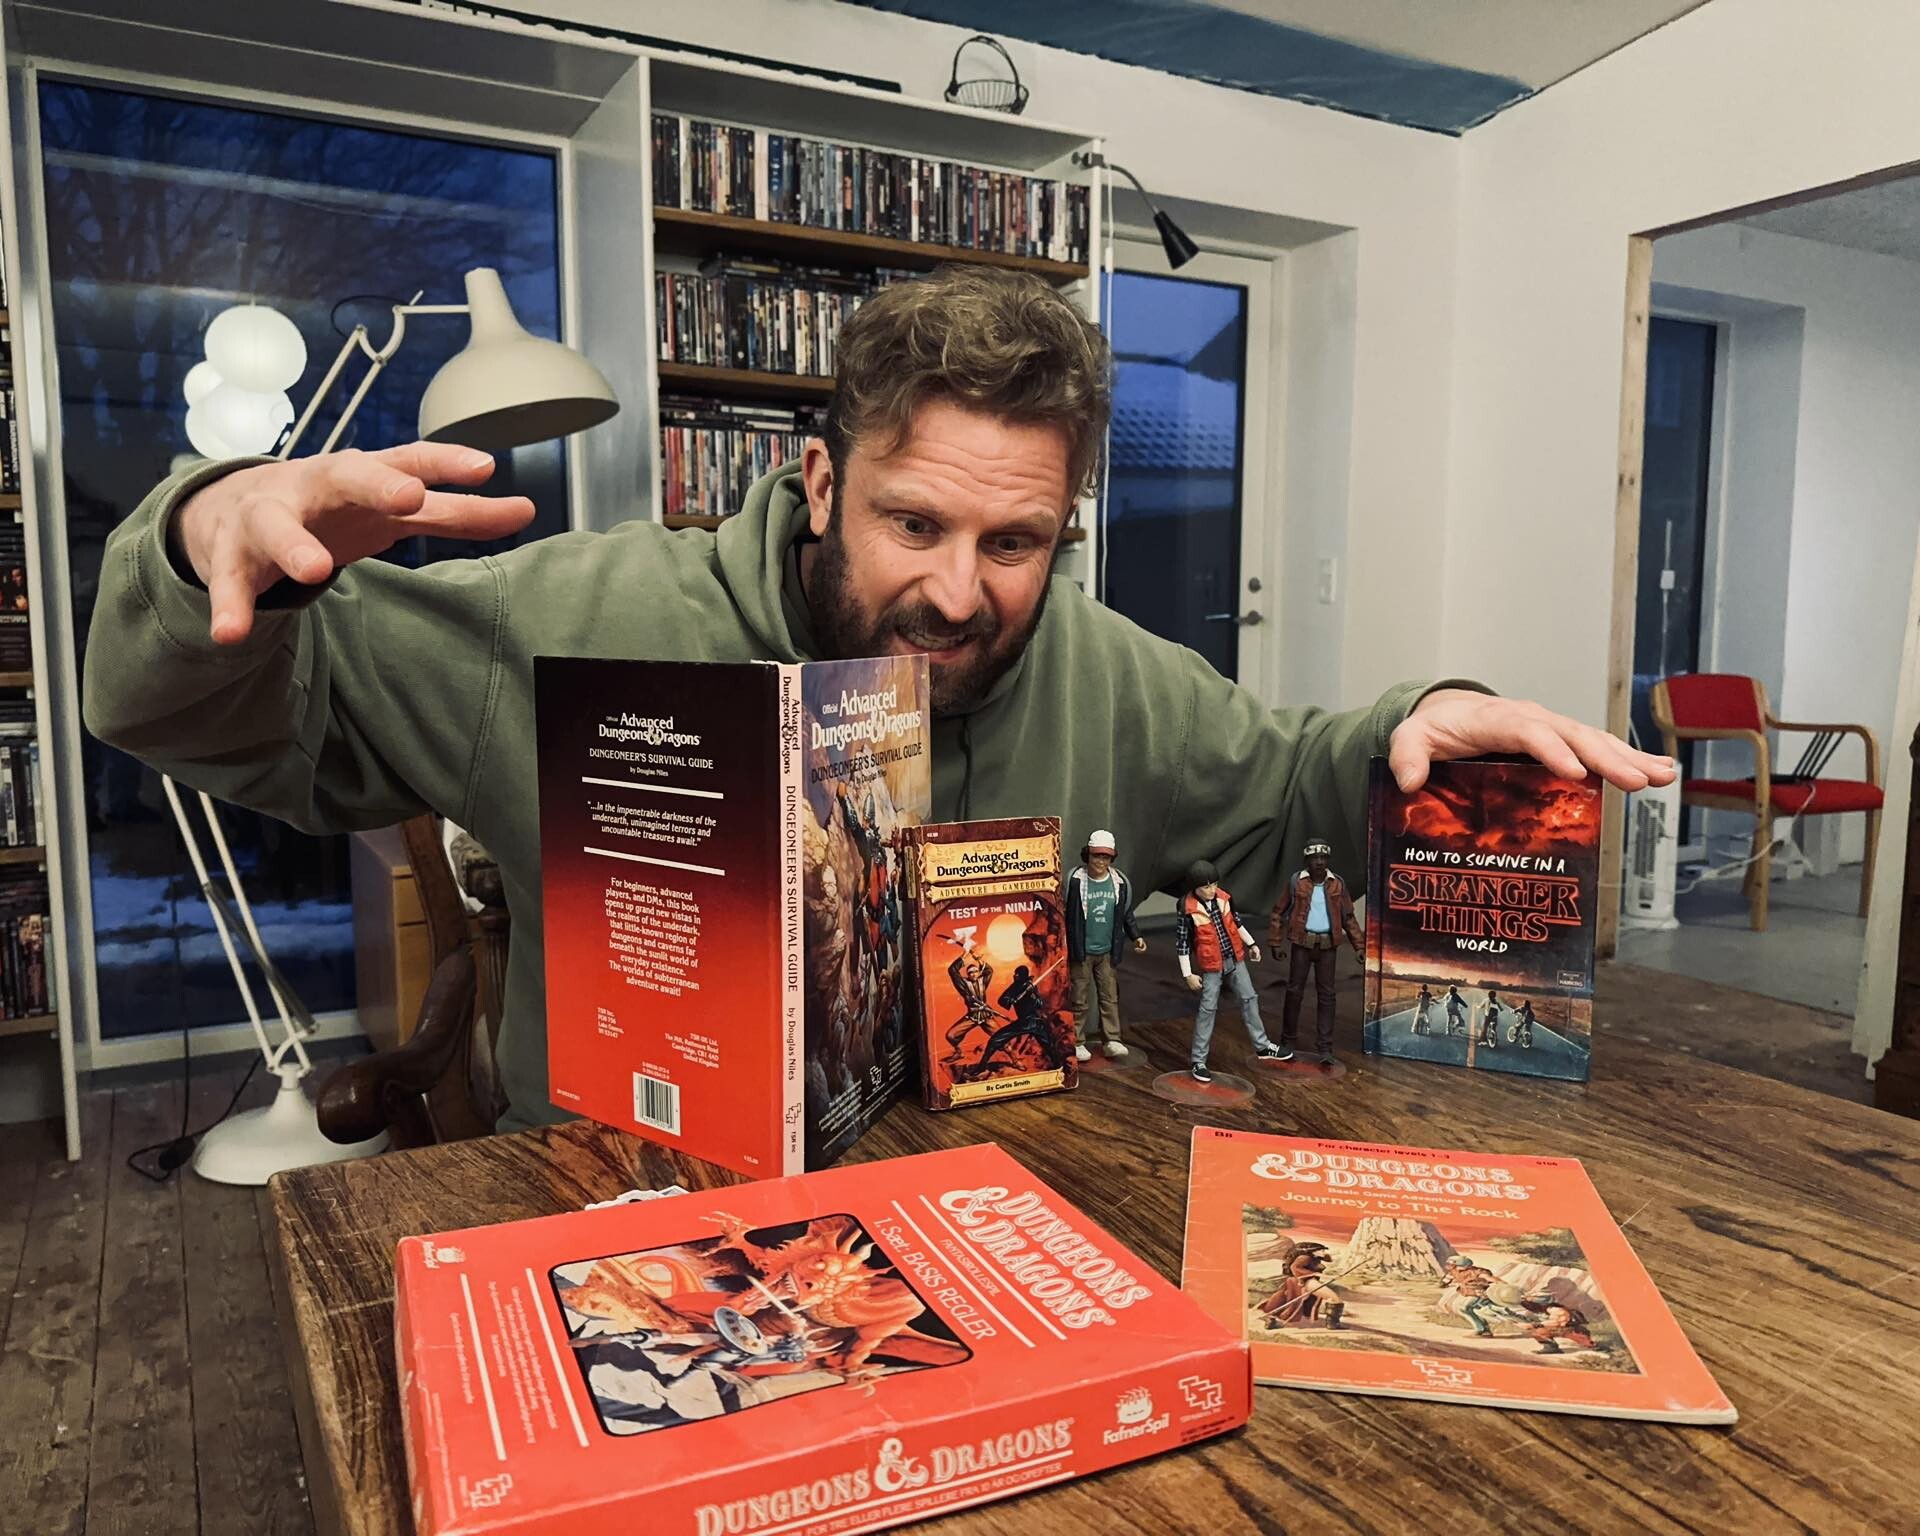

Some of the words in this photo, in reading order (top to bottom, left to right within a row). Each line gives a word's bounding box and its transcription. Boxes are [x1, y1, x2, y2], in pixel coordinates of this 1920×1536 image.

[839, 684, 897, 717] Advanced
[620, 712, 674, 730] Advanced
[792, 699, 800, 751] Advanced
[589, 748, 647, 762] DUNGEONEER'S
[648, 755, 687, 766] SURVIVAL
[688, 757, 714, 769] GUIDE
[636, 767, 655, 776] Douglas
[811, 756, 869, 784] DUNGEONEER'S
[870, 748, 902, 767] SURVIVAL
[903, 742, 922, 759] GUIDE
[592, 813, 629, 826] underearth,
[630, 818, 670, 831] unimagined
[671, 823, 696, 835] terrors
[697, 828, 711, 837] and
[605, 803, 615, 812] the
[617, 804, 661, 819] impenetrable
[661, 811, 693, 823] darkness
[695, 815, 703, 824] of
[704, 817, 716, 826] the
[601, 825, 641, 838] uncountable
[643, 831, 675, 843] treasures
[786, 785, 797, 885] DUNGEONEER'S
[961, 849, 1019, 864] Advanced
[1405, 848, 1439, 862] HOW
[1442, 852, 1461, 864] TO
[1466, 853, 1531, 869] SURVIVE
[1534, 857, 1555, 872] IN
[1557, 859, 1566, 874] A
[605, 888, 631, 900] players,
[633, 893, 645, 902] and
[666, 899, 680, 910] this
[681, 901, 699, 913] book
[611, 877, 622, 887] For
[624, 880, 659, 895] beginners,
[660, 888, 693, 901] advanced
[940, 885, 988, 897] ADVENTURE
[1002, 880, 1046, 891] GAMEBOOK
[1389, 869, 1581, 920] STRANGER
[604, 899, 624, 910] opens
[625, 903, 634, 912] up
[635, 905, 655, 915] grand
[656, 909, 670, 918] new
[671, 911, 692, 923] vistas
[694, 915, 701, 925] in
[606, 908, 617, 918] the
[618, 911, 640, 922] realms
[641, 916, 649, 925] of
[649, 917, 661, 927] the
[787, 888, 798, 950] SURVIVAL
[948, 907, 978, 920] TEST
[1005, 901, 1043, 914] NINJA
[1418, 903, 1548, 942] THINGS
[610, 920, 623, 930] that
[624, 922, 664, 938] little-known
[665, 932, 688, 943] region
[689, 937, 697, 945] of
[610, 930, 642, 944] dungeons
[643, 939, 657, 948] and
[657, 942, 684, 954] caverns
[685, 946, 696, 956] far
[609, 940, 635, 954] beneath
[636, 946, 647, 956] the
[649, 950, 668, 961] sunlit
[669, 955, 689, 966] world
[690, 959, 698, 968] of
[1456, 938, 1508, 954] WORLD
[608, 960, 622, 971] The
[623, 965, 645, 976] worlds
[645, 970, 653, 978] of
[654, 973, 700, 990] subterranean
[620, 954, 650, 969] everyday
[651, 961, 687, 976] existence.
[788, 953, 798, 992] GUIDE
[626, 976, 660, 991] adventure
[787, 1008, 795, 1021] by
[786, 1023, 797, 1056] Douglas
[788, 1058, 797, 1081] Niles
[1339, 1145, 1390, 1154] character
[1394, 1149, 1427, 1158] levels
[1250, 1153, 1322, 1183] &
[1323, 1168, 1531, 1201] DRAGONS
[1289, 1150, 1514, 1183] DUNGEONS
[939, 1185, 1009, 1226] &
[1280, 1191, 1368, 1208] Journey
[1377, 1201, 1400, 1210] to
[1407, 1202, 1453, 1214] The
[1460, 1206, 1521, 1220] Rock
[1363, 1190, 1397, 1199] Game
[1401, 1194, 1463, 1204] Adventure
[993, 1191, 1152, 1310] DUNGEONS
[964, 1219, 1110, 1329] DRAGONS
[902, 1251, 949, 1289] BASIS
[934, 1287, 998, 1340] REGLER
[1104, 1412, 1170, 1445] FafnerSpil
[695, 1464, 871, 1536] DUNGEONS
[874, 1437, 929, 1492] &
[930, 1419, 1072, 1483] DRAGONS
[915, 1492, 959, 1508] SPILLERE
